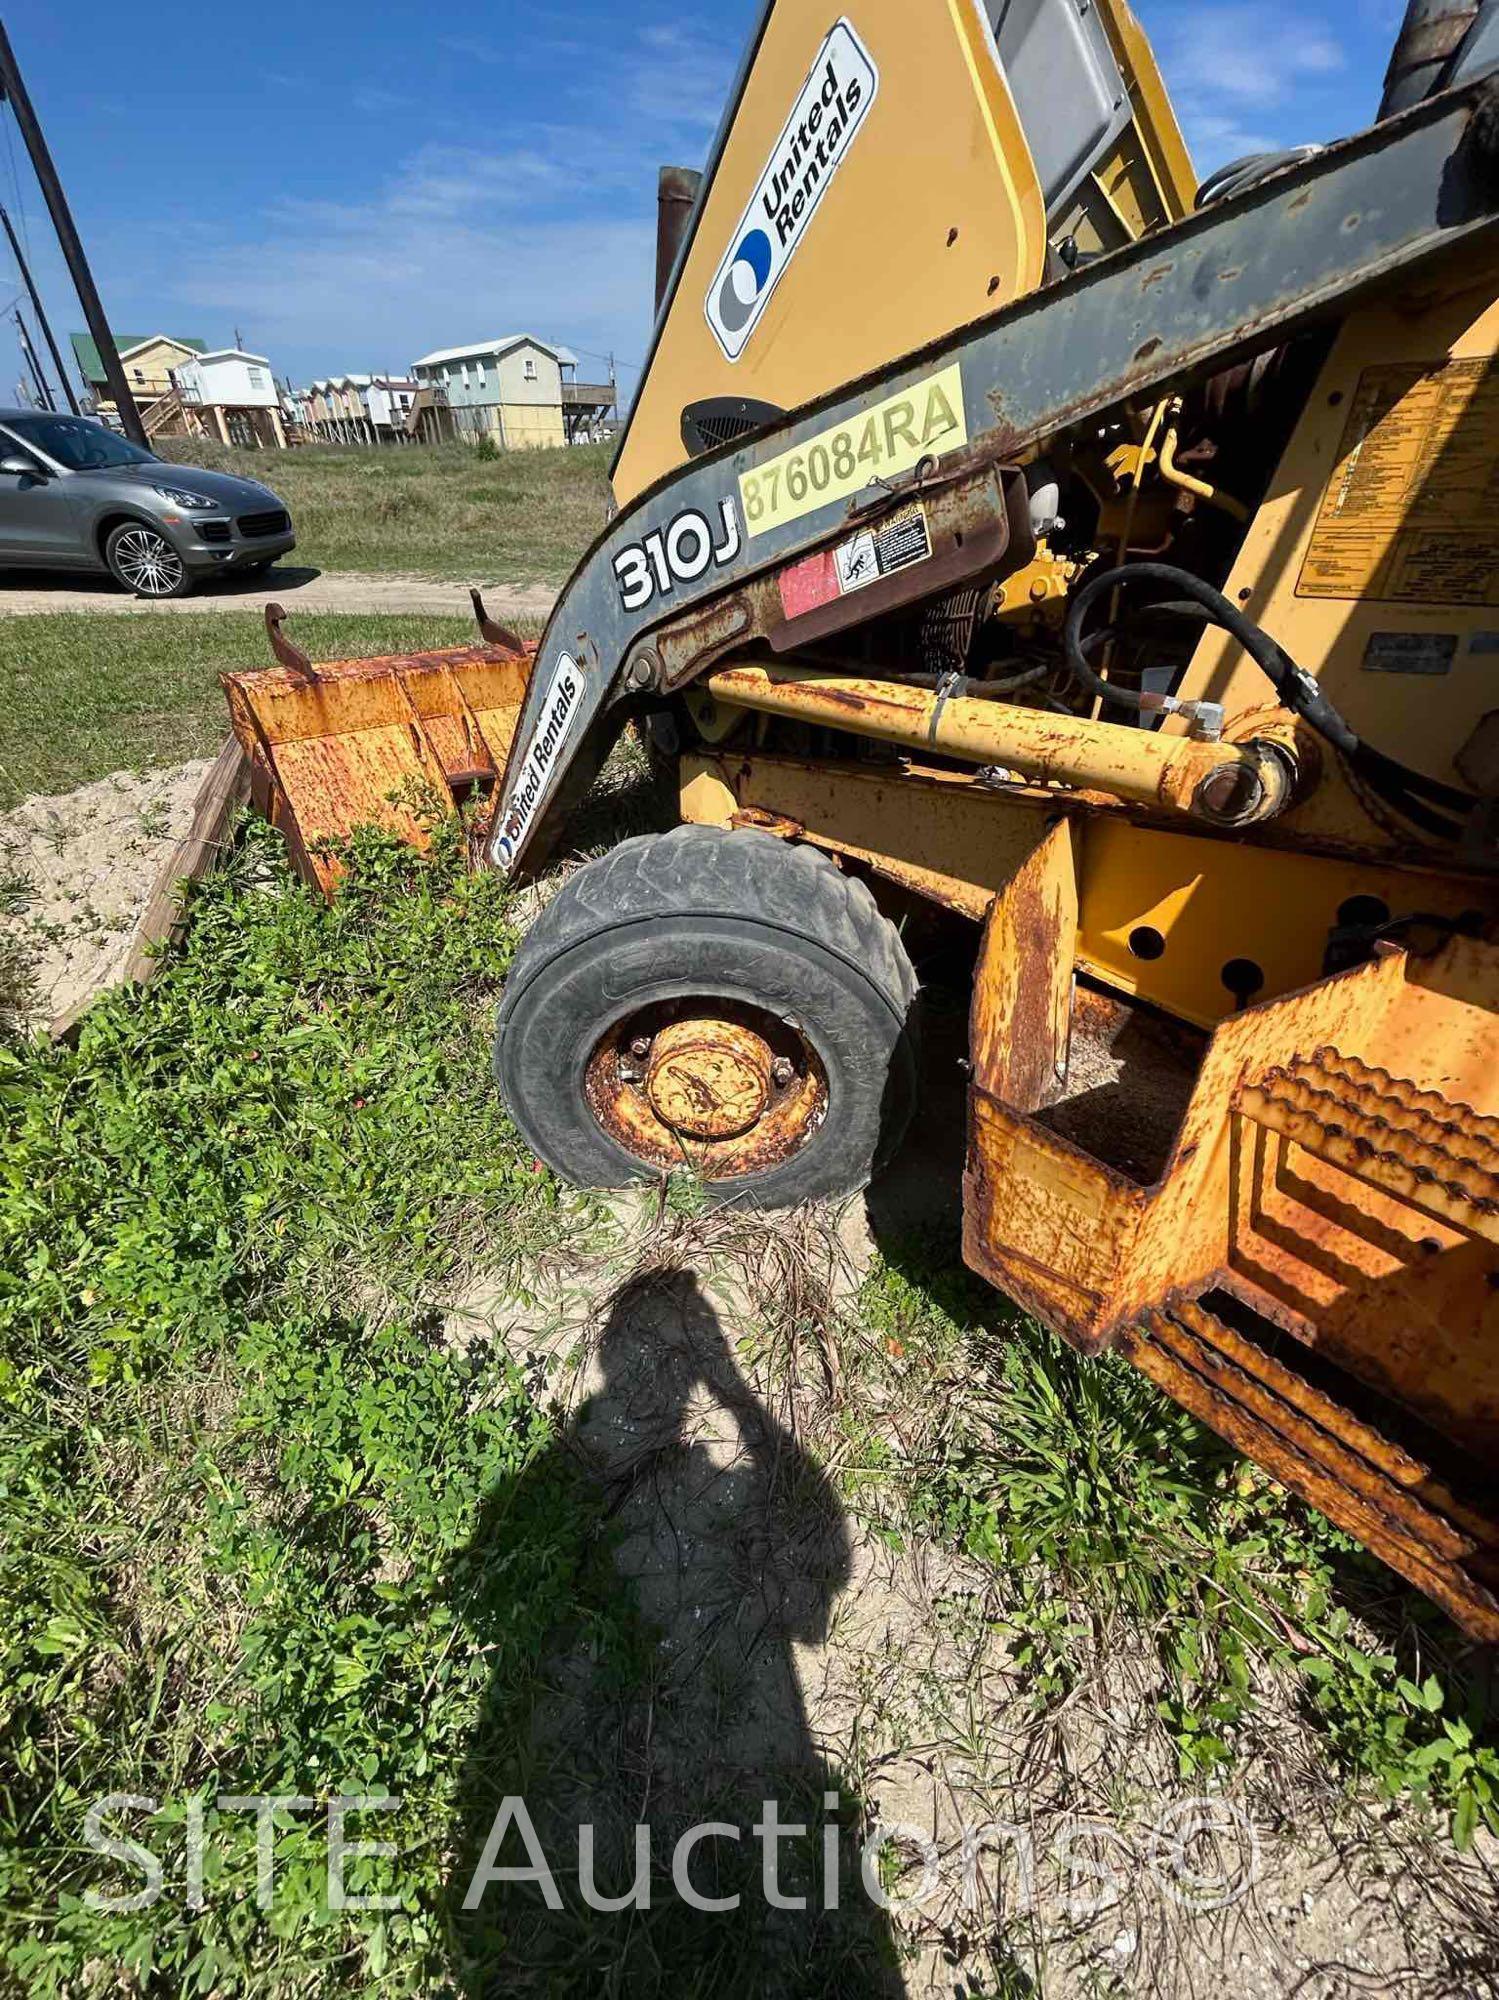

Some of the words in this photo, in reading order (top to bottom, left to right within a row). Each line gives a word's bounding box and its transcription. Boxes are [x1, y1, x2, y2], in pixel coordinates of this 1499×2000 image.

[763, 60, 838, 219] United
[775, 78, 861, 247] Rentals
[743, 384, 958, 521] 876084RA
[612, 495, 740, 613] 310J
[533, 675, 576, 772] Rentals
